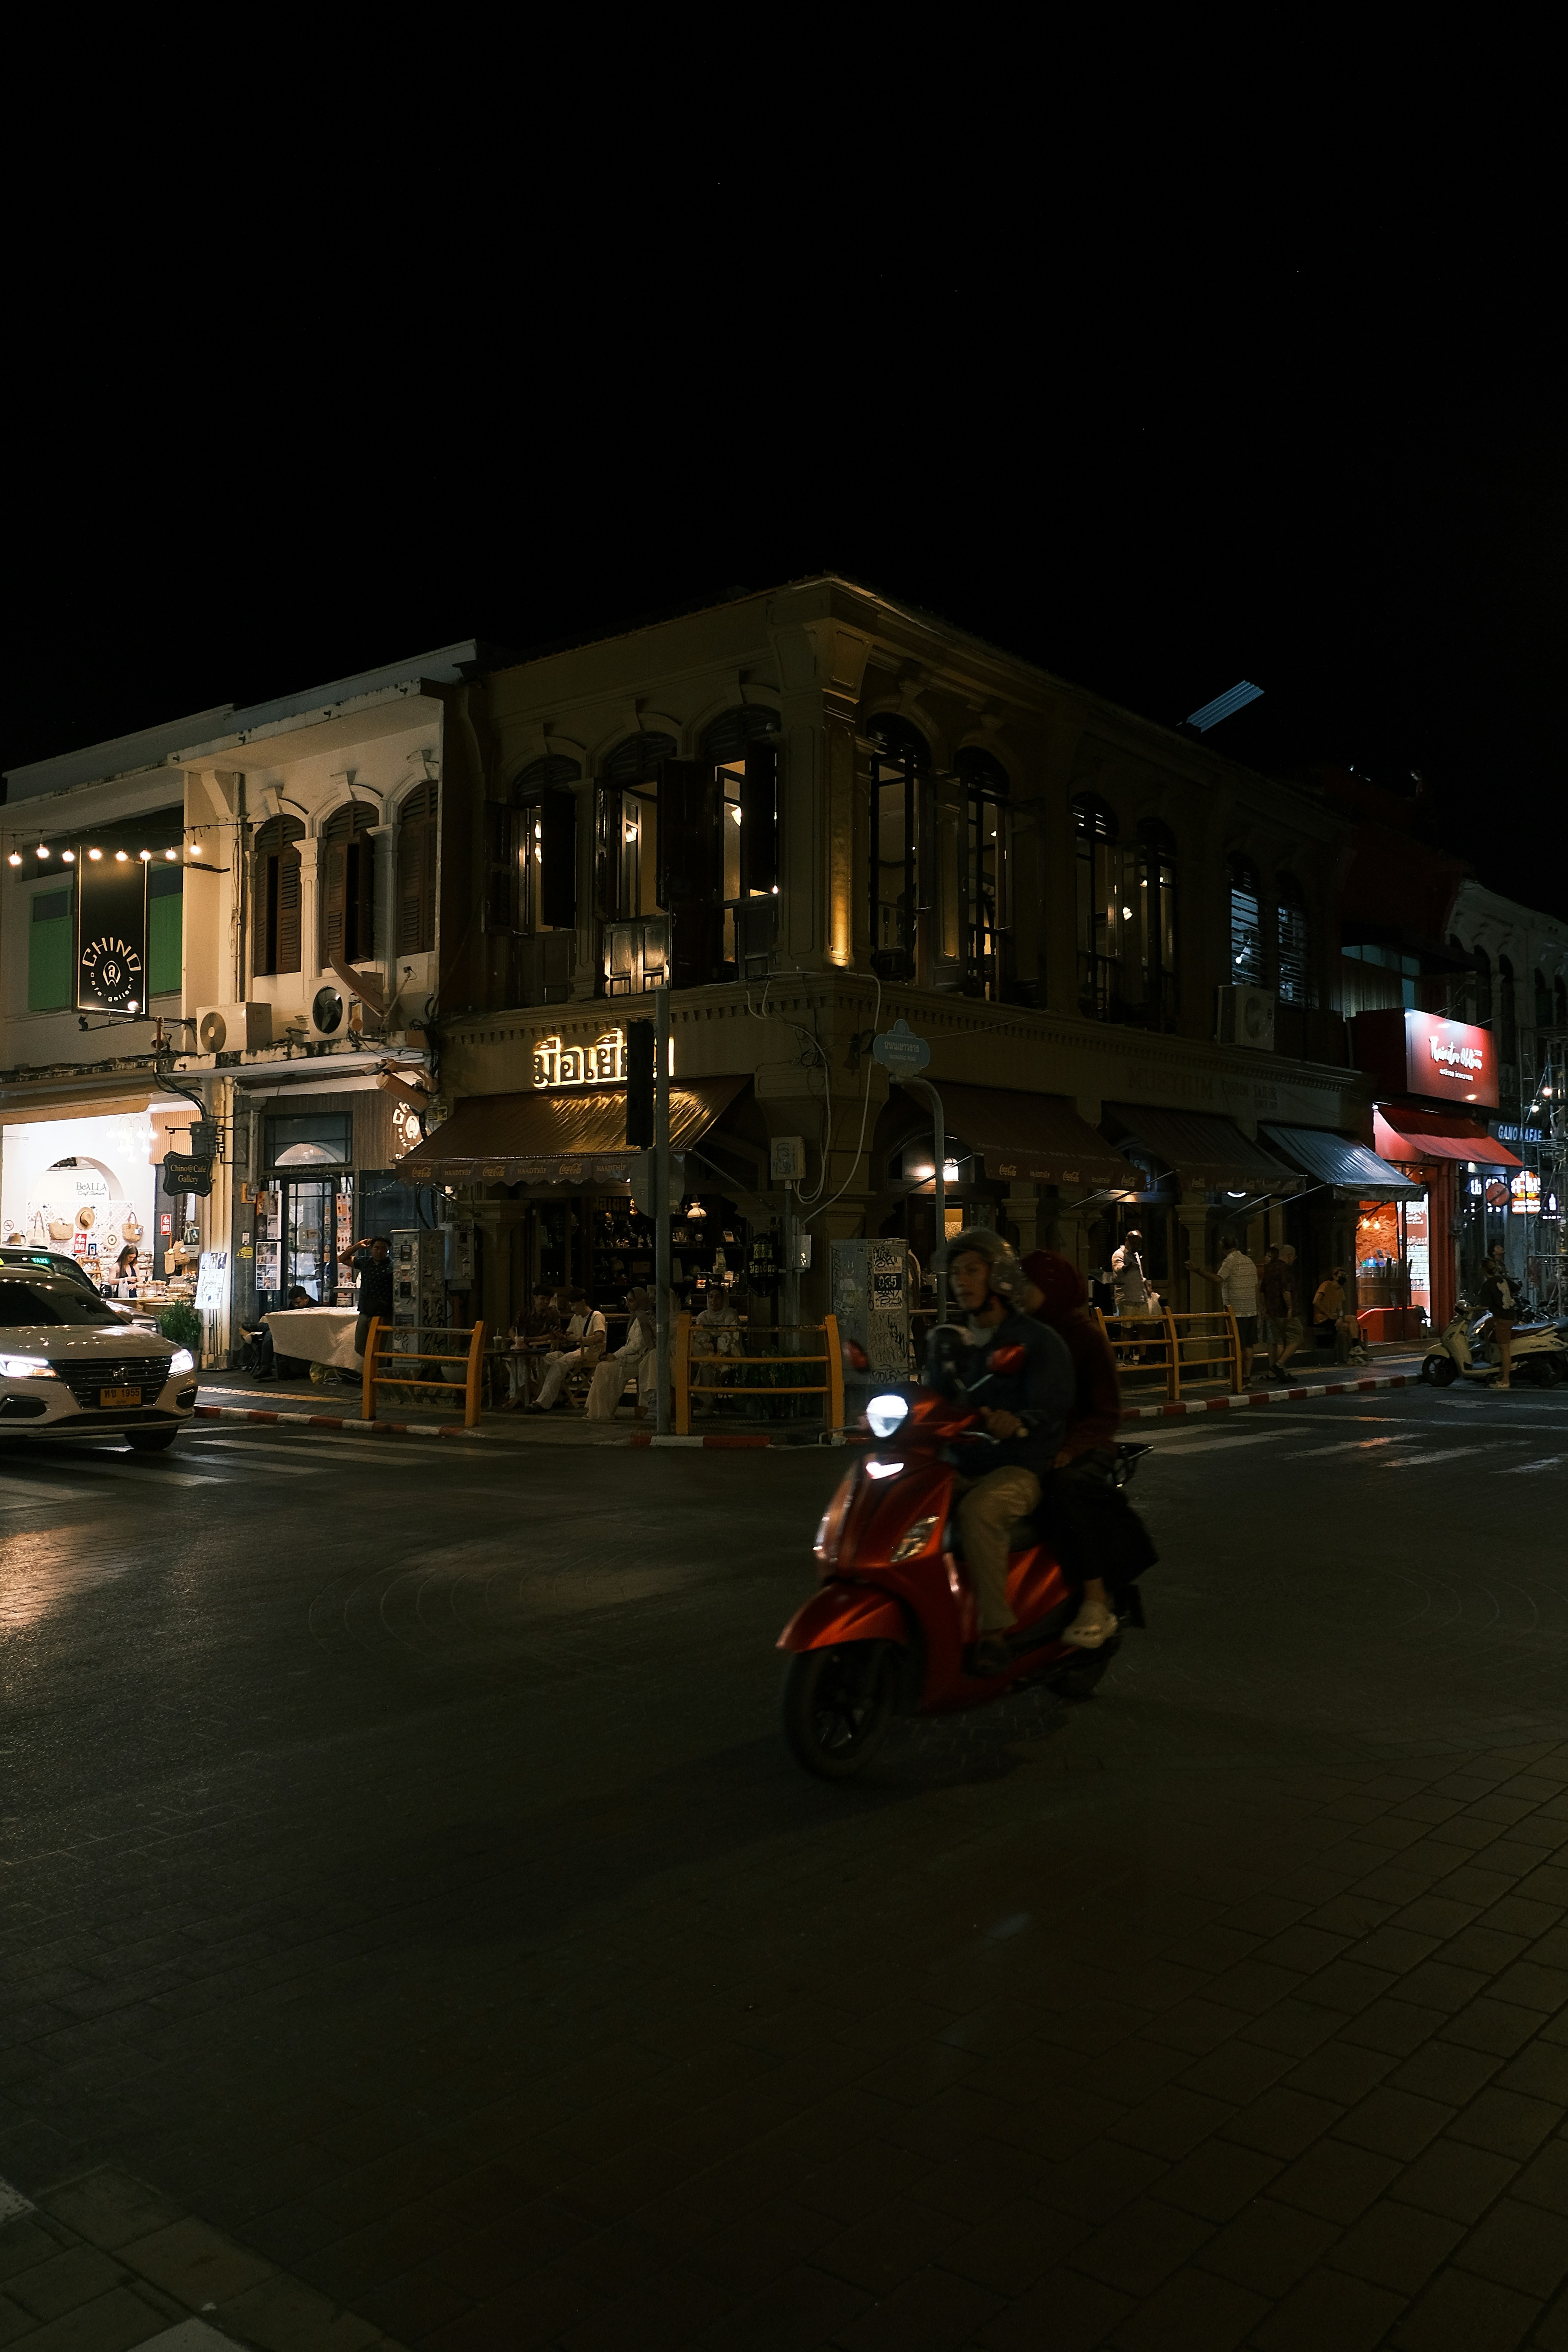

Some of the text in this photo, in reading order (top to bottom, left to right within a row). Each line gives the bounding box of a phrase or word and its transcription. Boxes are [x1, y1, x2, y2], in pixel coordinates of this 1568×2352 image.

[82, 937, 141, 971] CHINO
[1498, 1125, 1518, 1141] GANO
[412, 1167, 432, 1177] Coca-Cola
[482, 1166, 505, 1176] Coca-Cola
[559, 1163, 583, 1174] Coca-Cola
[999, 1164, 1017, 1176] Coca-Cola
[1063, 1170, 1080, 1182] Coca-Cola
[178, 1174, 199, 1184] Gallery
[121, 1388, 140, 1398] 1955
